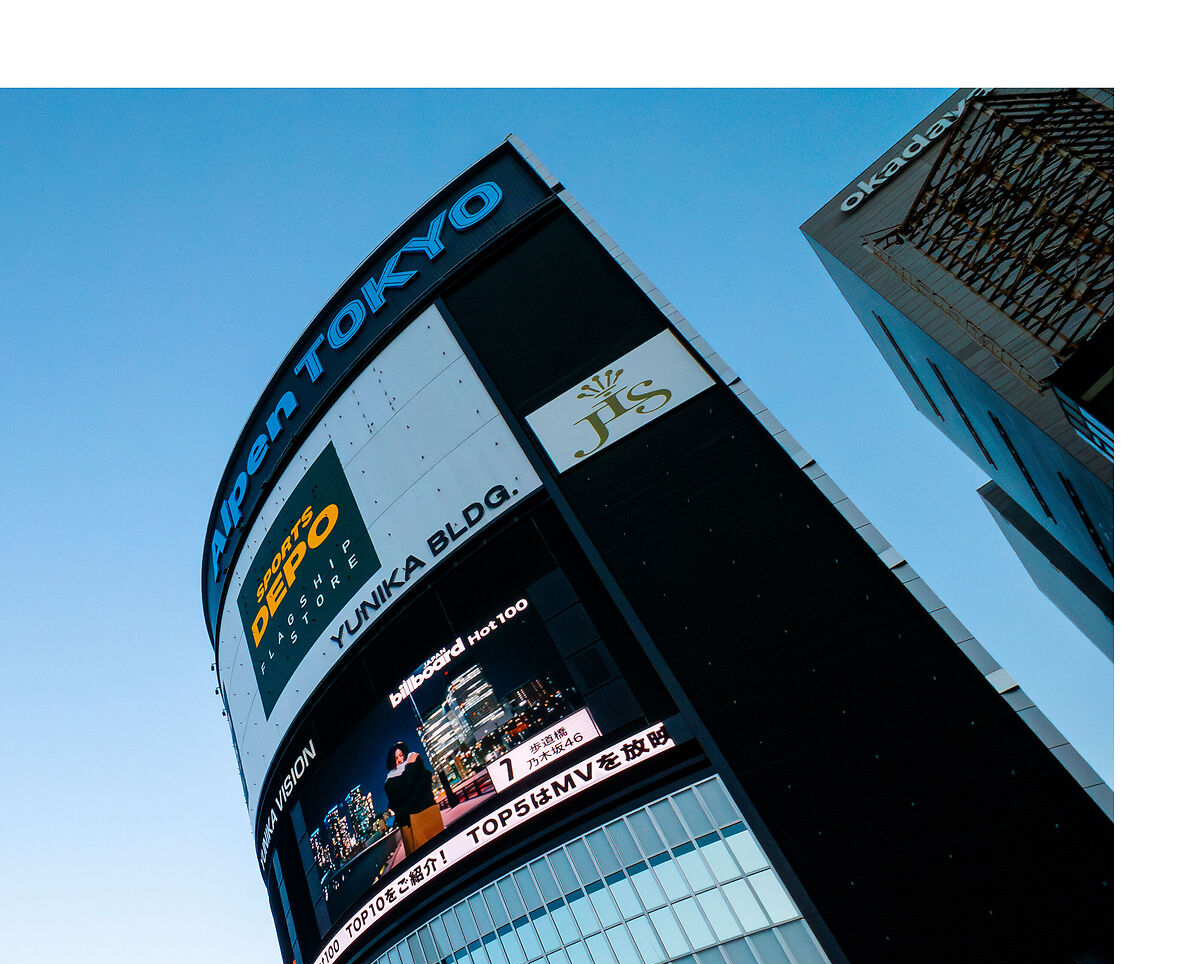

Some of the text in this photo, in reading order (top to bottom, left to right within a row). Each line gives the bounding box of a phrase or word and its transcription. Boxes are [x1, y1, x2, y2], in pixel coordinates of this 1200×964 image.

[209, 180, 503, 583] Alpen TOKYO
[250, 502, 339, 648] DEPO
[255, 505, 314, 603] SPORTS
[329, 484, 519, 650] YUNIKA BLDG.
[389, 598, 529, 708] billboard Hot 100
[423, 646, 448, 669] JAPAN
[275, 739, 318, 812] VISION
[527, 731, 584, 770] 乃木坂46
[530, 726, 569, 754] 歩道橋
